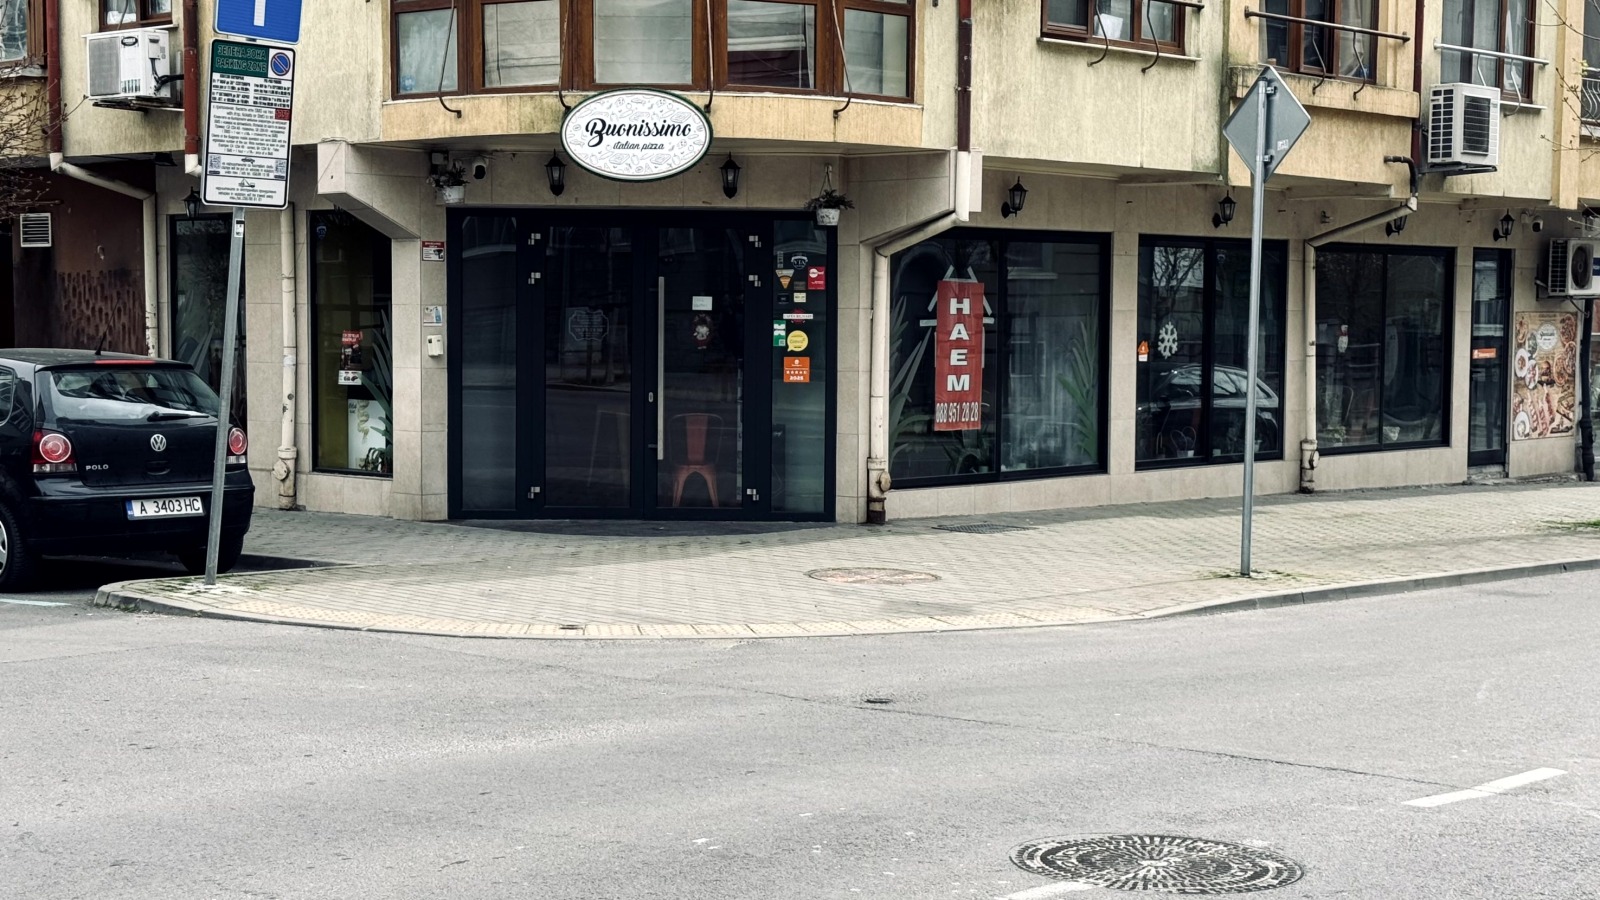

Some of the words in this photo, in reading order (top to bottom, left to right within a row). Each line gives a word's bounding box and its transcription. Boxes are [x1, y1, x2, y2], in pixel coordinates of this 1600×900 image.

[215, 57, 247, 70] PARKING
[247, 60, 267, 73] ZONE
[585, 117, 692, 148] Buonissimo
[613, 140, 640, 150] italian
[641, 142, 665, 152] pizza
[936, 402, 948, 423] 088
[948, 402, 960, 423] 951
[961, 401, 970, 422] 28
[970, 401, 979, 422] 28
[85, 463, 109, 471] POLO
[140, 501, 148, 515] A
[153, 499, 183, 514] 3403
[183, 498, 201, 512] HC
